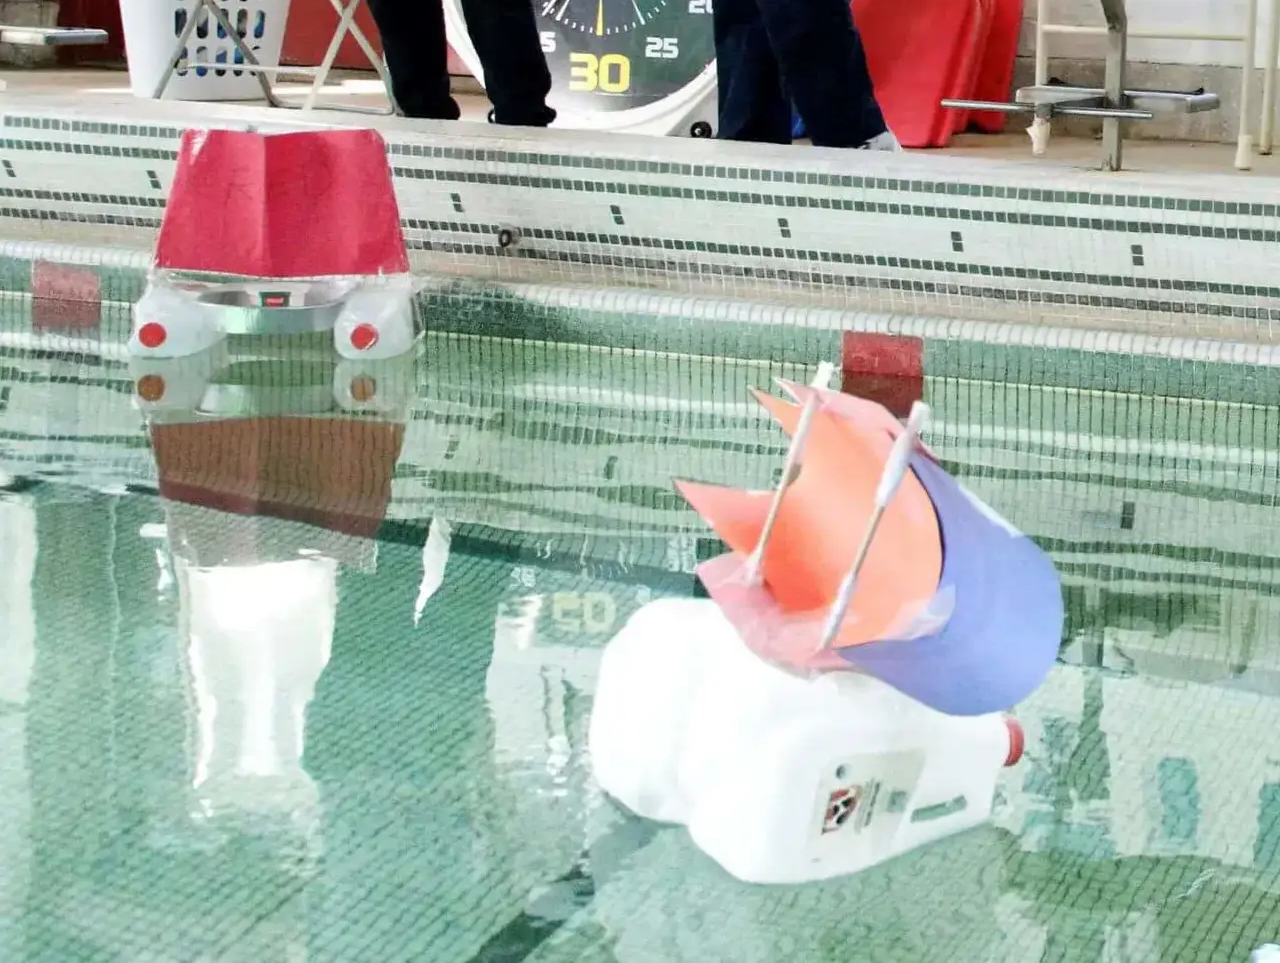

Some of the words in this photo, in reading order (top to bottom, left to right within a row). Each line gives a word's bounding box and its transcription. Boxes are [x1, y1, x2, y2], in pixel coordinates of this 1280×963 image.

[540, 31, 557, 54] 5
[644, 36, 679, 58] 25
[568, 52, 631, 94] 30
